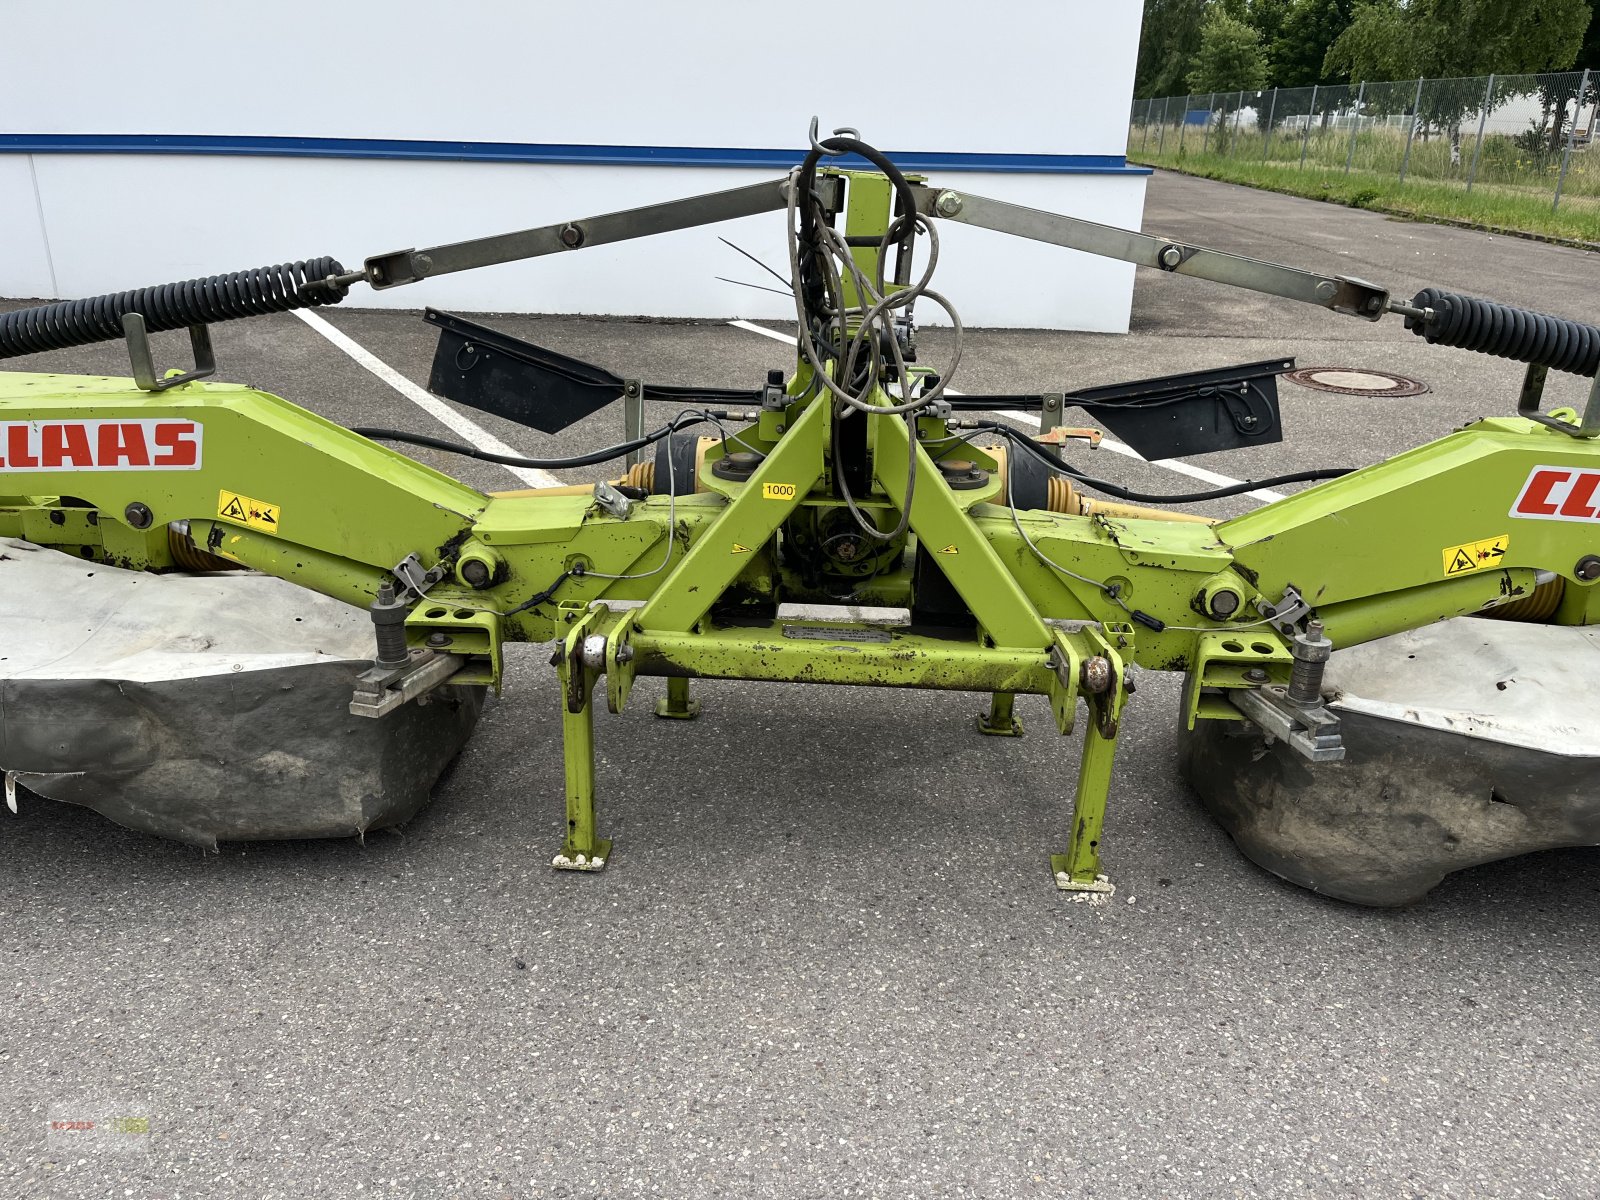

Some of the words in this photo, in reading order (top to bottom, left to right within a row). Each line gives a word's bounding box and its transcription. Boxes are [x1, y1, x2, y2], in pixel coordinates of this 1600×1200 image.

[0, 423, 197, 467] LAAS
[767, 485, 794, 496] 1000
[1516, 470, 1600, 518] CL
